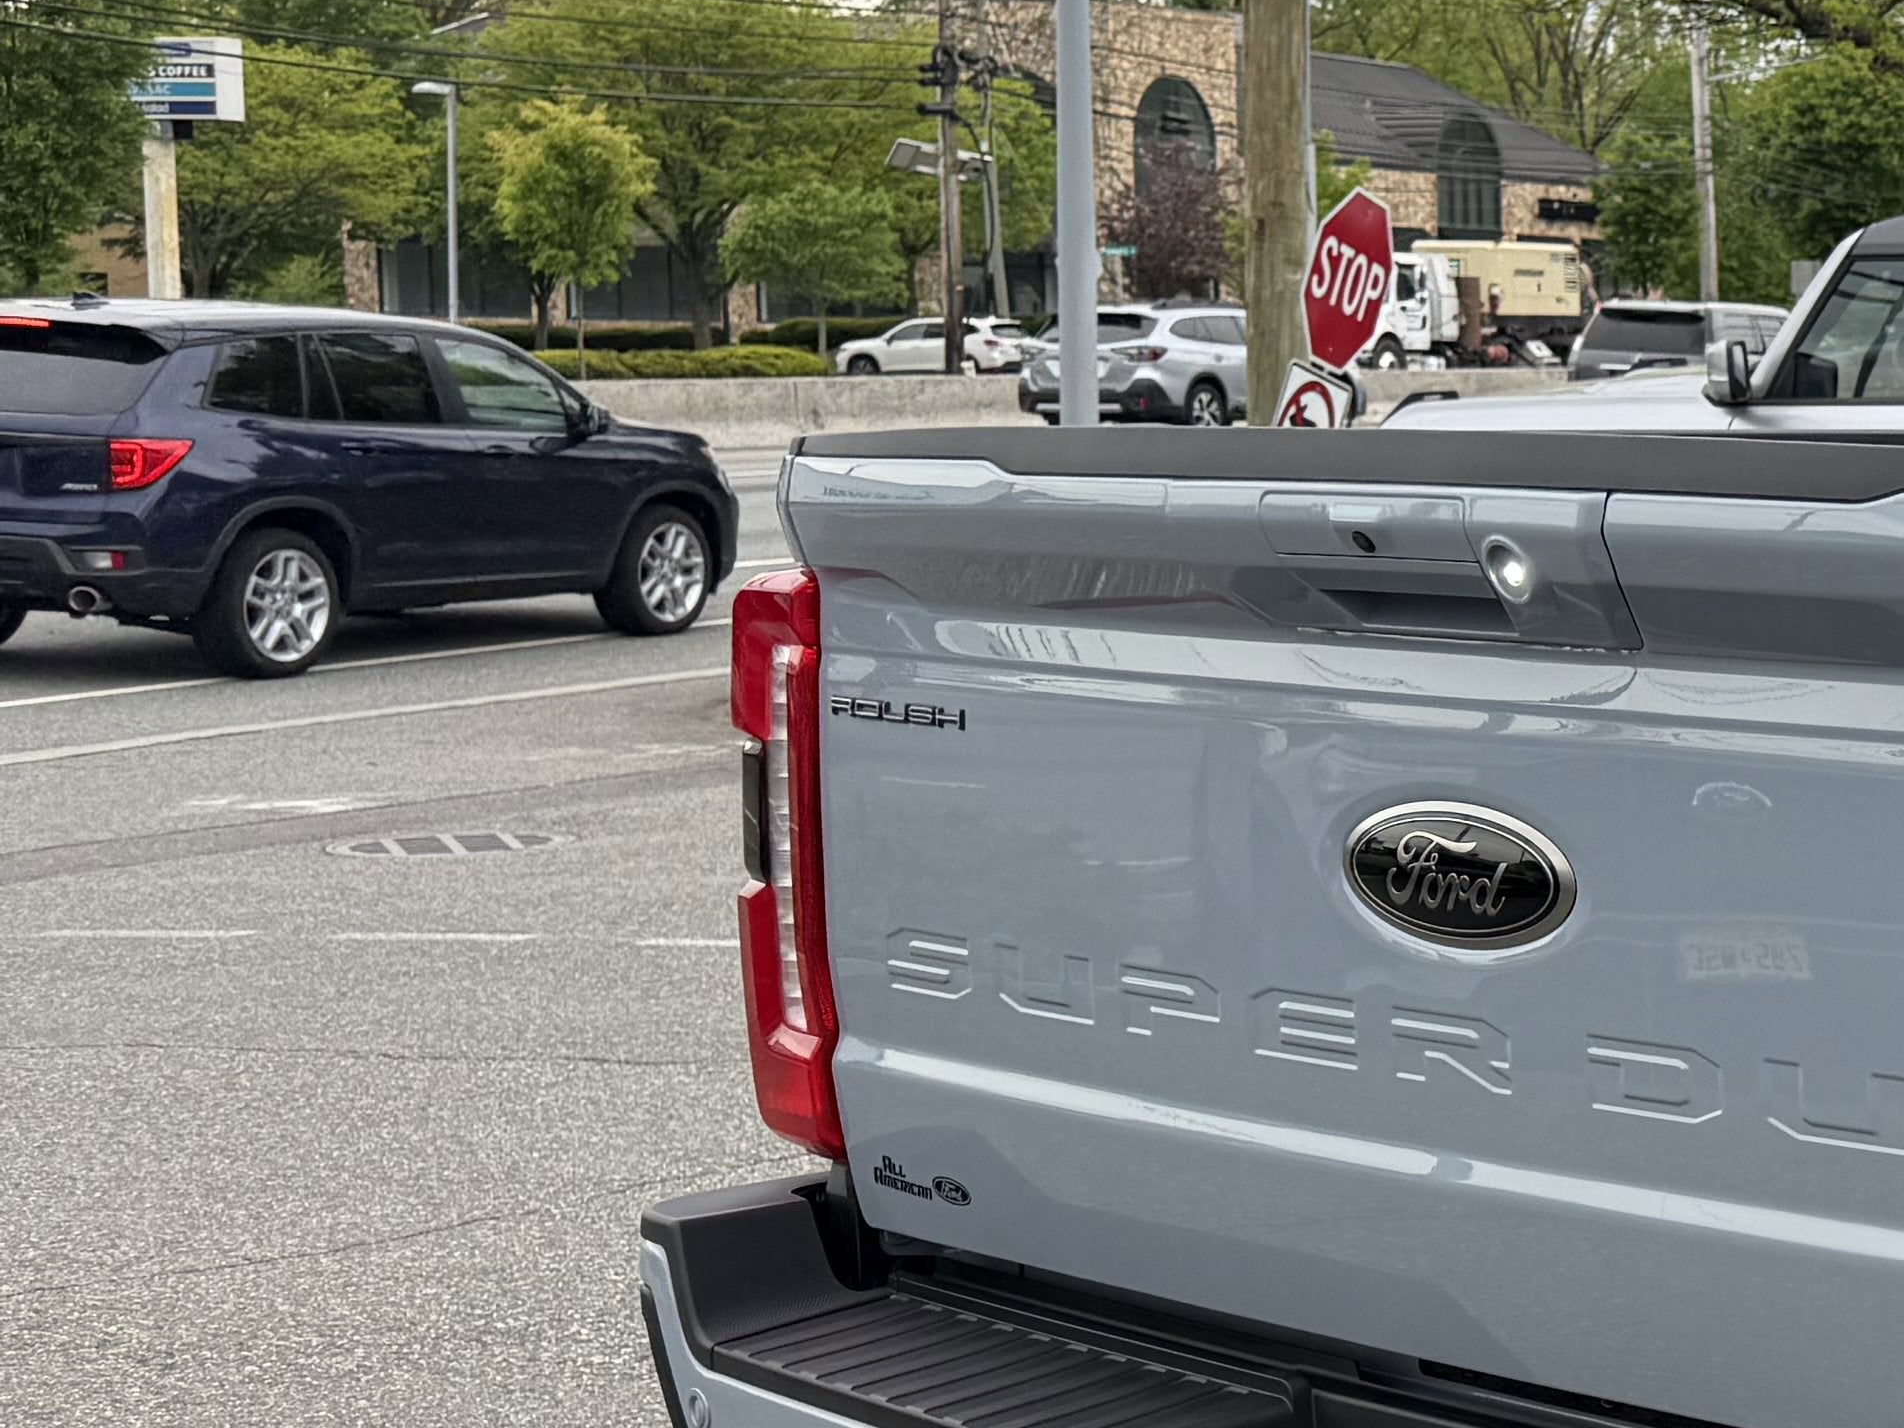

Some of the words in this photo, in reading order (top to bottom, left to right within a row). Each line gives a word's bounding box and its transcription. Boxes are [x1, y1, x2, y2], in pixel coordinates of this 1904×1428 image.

[158, 65, 208, 77] COFFEE
[1310, 234, 1387, 322] STOP
[829, 693, 967, 733] ROUSH
[1386, 830, 1508, 917] Ford
[885, 926, 1513, 1096] SUPER
[873, 1166, 933, 1201] AMERICAN
[881, 1155, 907, 1178] ALL
